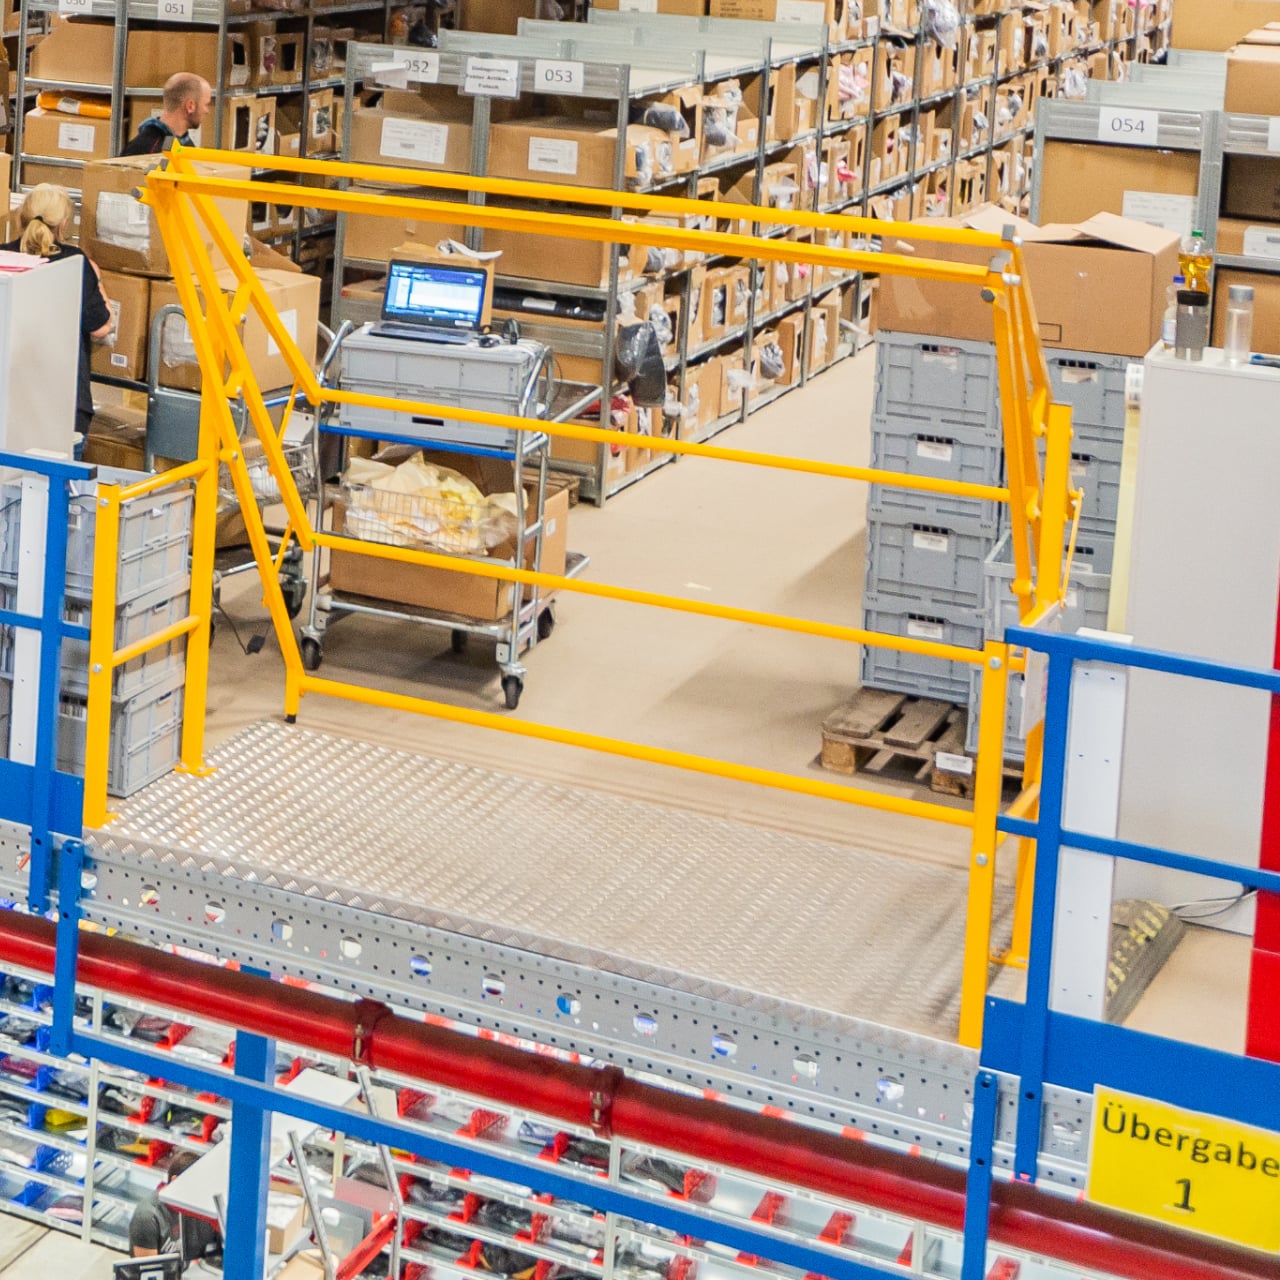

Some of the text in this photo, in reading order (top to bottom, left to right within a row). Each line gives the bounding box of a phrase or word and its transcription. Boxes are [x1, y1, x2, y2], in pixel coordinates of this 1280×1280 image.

[164, 2, 185, 14] 051
[545, 68, 573, 83] 053
[1111, 117, 1145, 133] 054
[1102, 1101, 1280, 1178] Übergabe
[1173, 1177, 1196, 1213] 1
